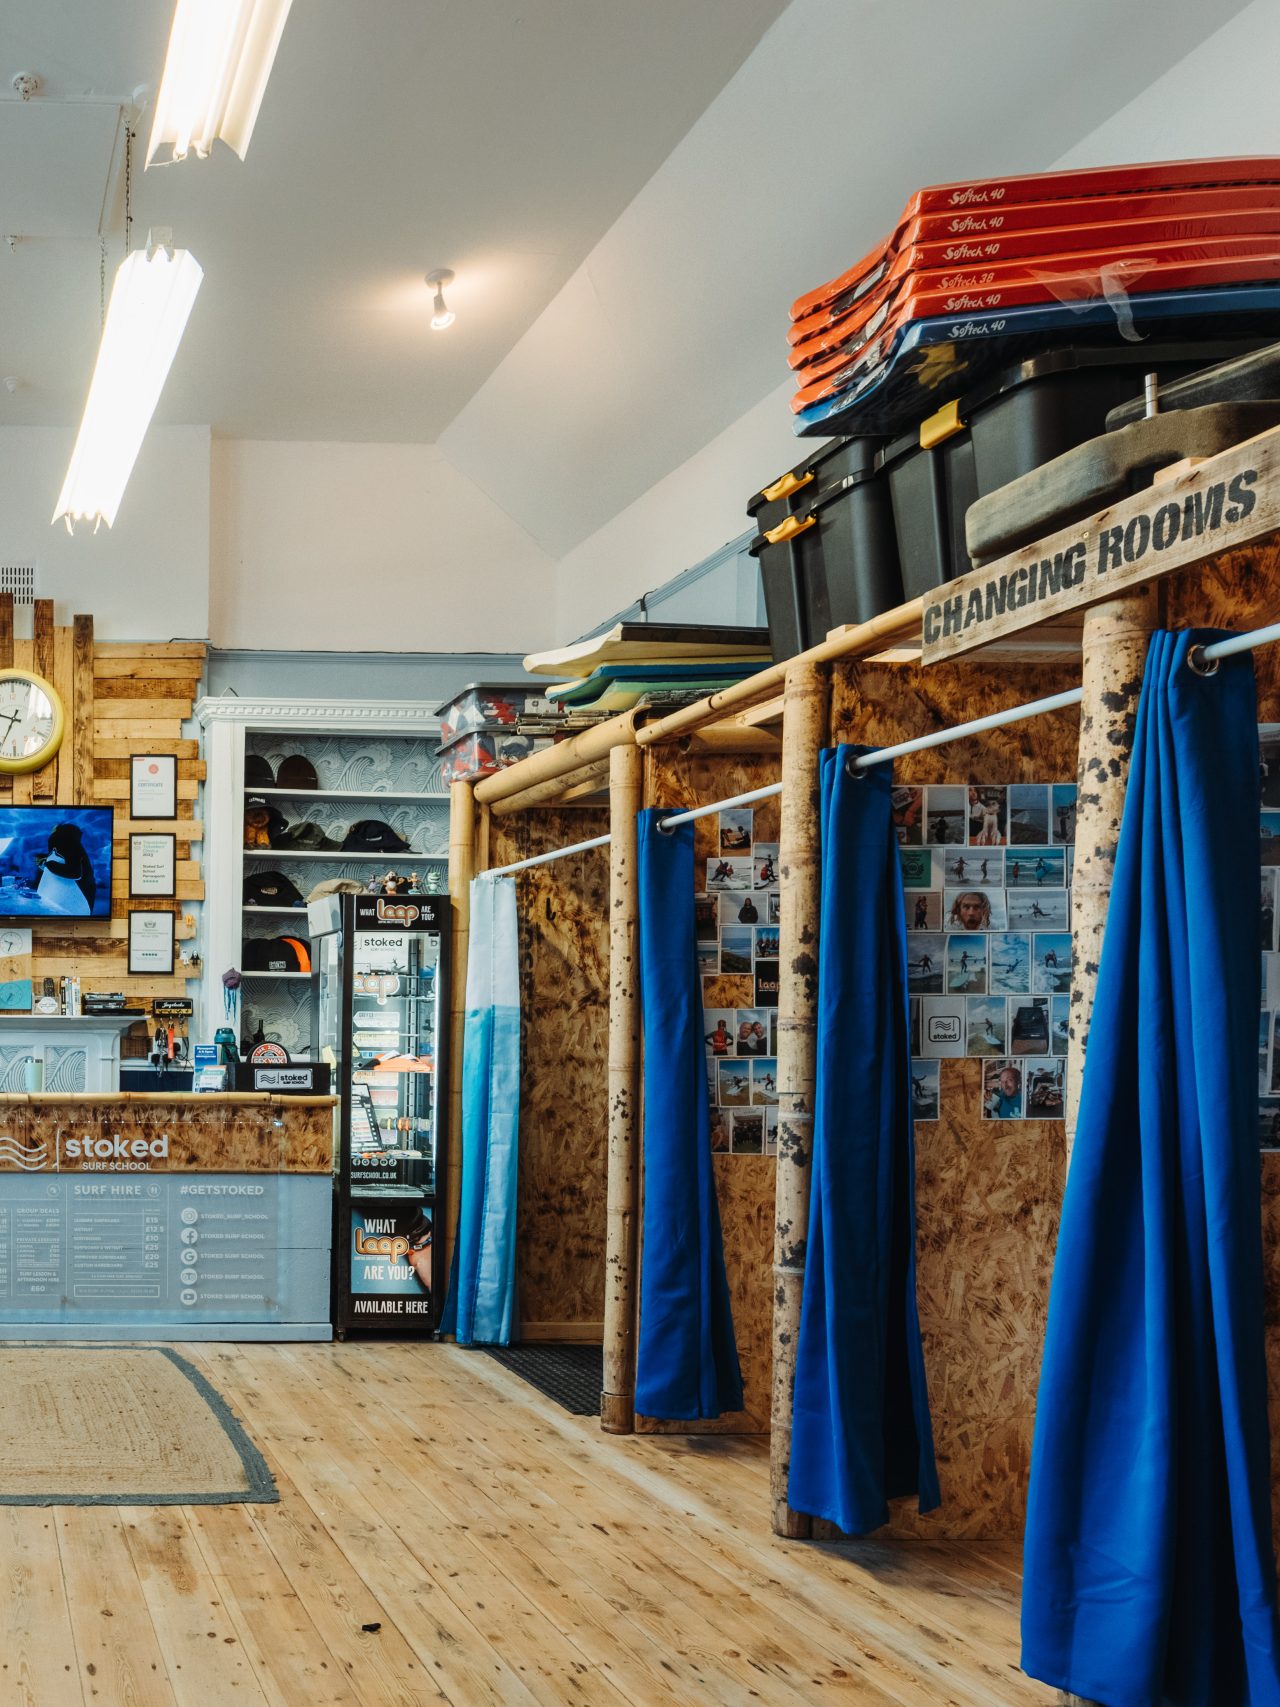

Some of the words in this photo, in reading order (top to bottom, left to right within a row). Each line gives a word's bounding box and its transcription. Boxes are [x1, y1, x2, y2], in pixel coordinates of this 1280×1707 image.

[948, 188, 988, 204] Softech
[990, 188, 1005, 199] 40
[947, 216, 988, 232] Softech
[989, 217, 1004, 227] 40
[942, 244, 983, 260] Softech
[985, 243, 1000, 254] 40
[937, 273, 977, 289] Softech
[980, 272, 994, 283] 38
[943, 294, 984, 310] Softech
[986, 294, 1001, 305] 40
[948, 321, 989, 337] Softech
[991, 320, 1006, 331] 40
[923, 541, 1087, 644] CHANGING
[1097, 469, 1258, 574] ROOMS
[359, 908, 375, 916] WHAT
[364, 937, 403, 946] stoked
[66, 1135, 168, 1157] stoked
[82, 1162, 107, 1170] SURF
[109, 1162, 150, 1170] SCHOOL
[74, 1185, 107, 1195] SURF
[111, 1185, 141, 1195] HIRE
[180, 1185, 264, 1195] #GETSTOKED
[364, 1219, 396, 1234] WHAT
[364, 1266, 384, 1280] ARE
[387, 1266, 415, 1280] YOU?
[354, 1301, 403, 1313] AVAILABLE
[406, 1302, 428, 1314] HERE
